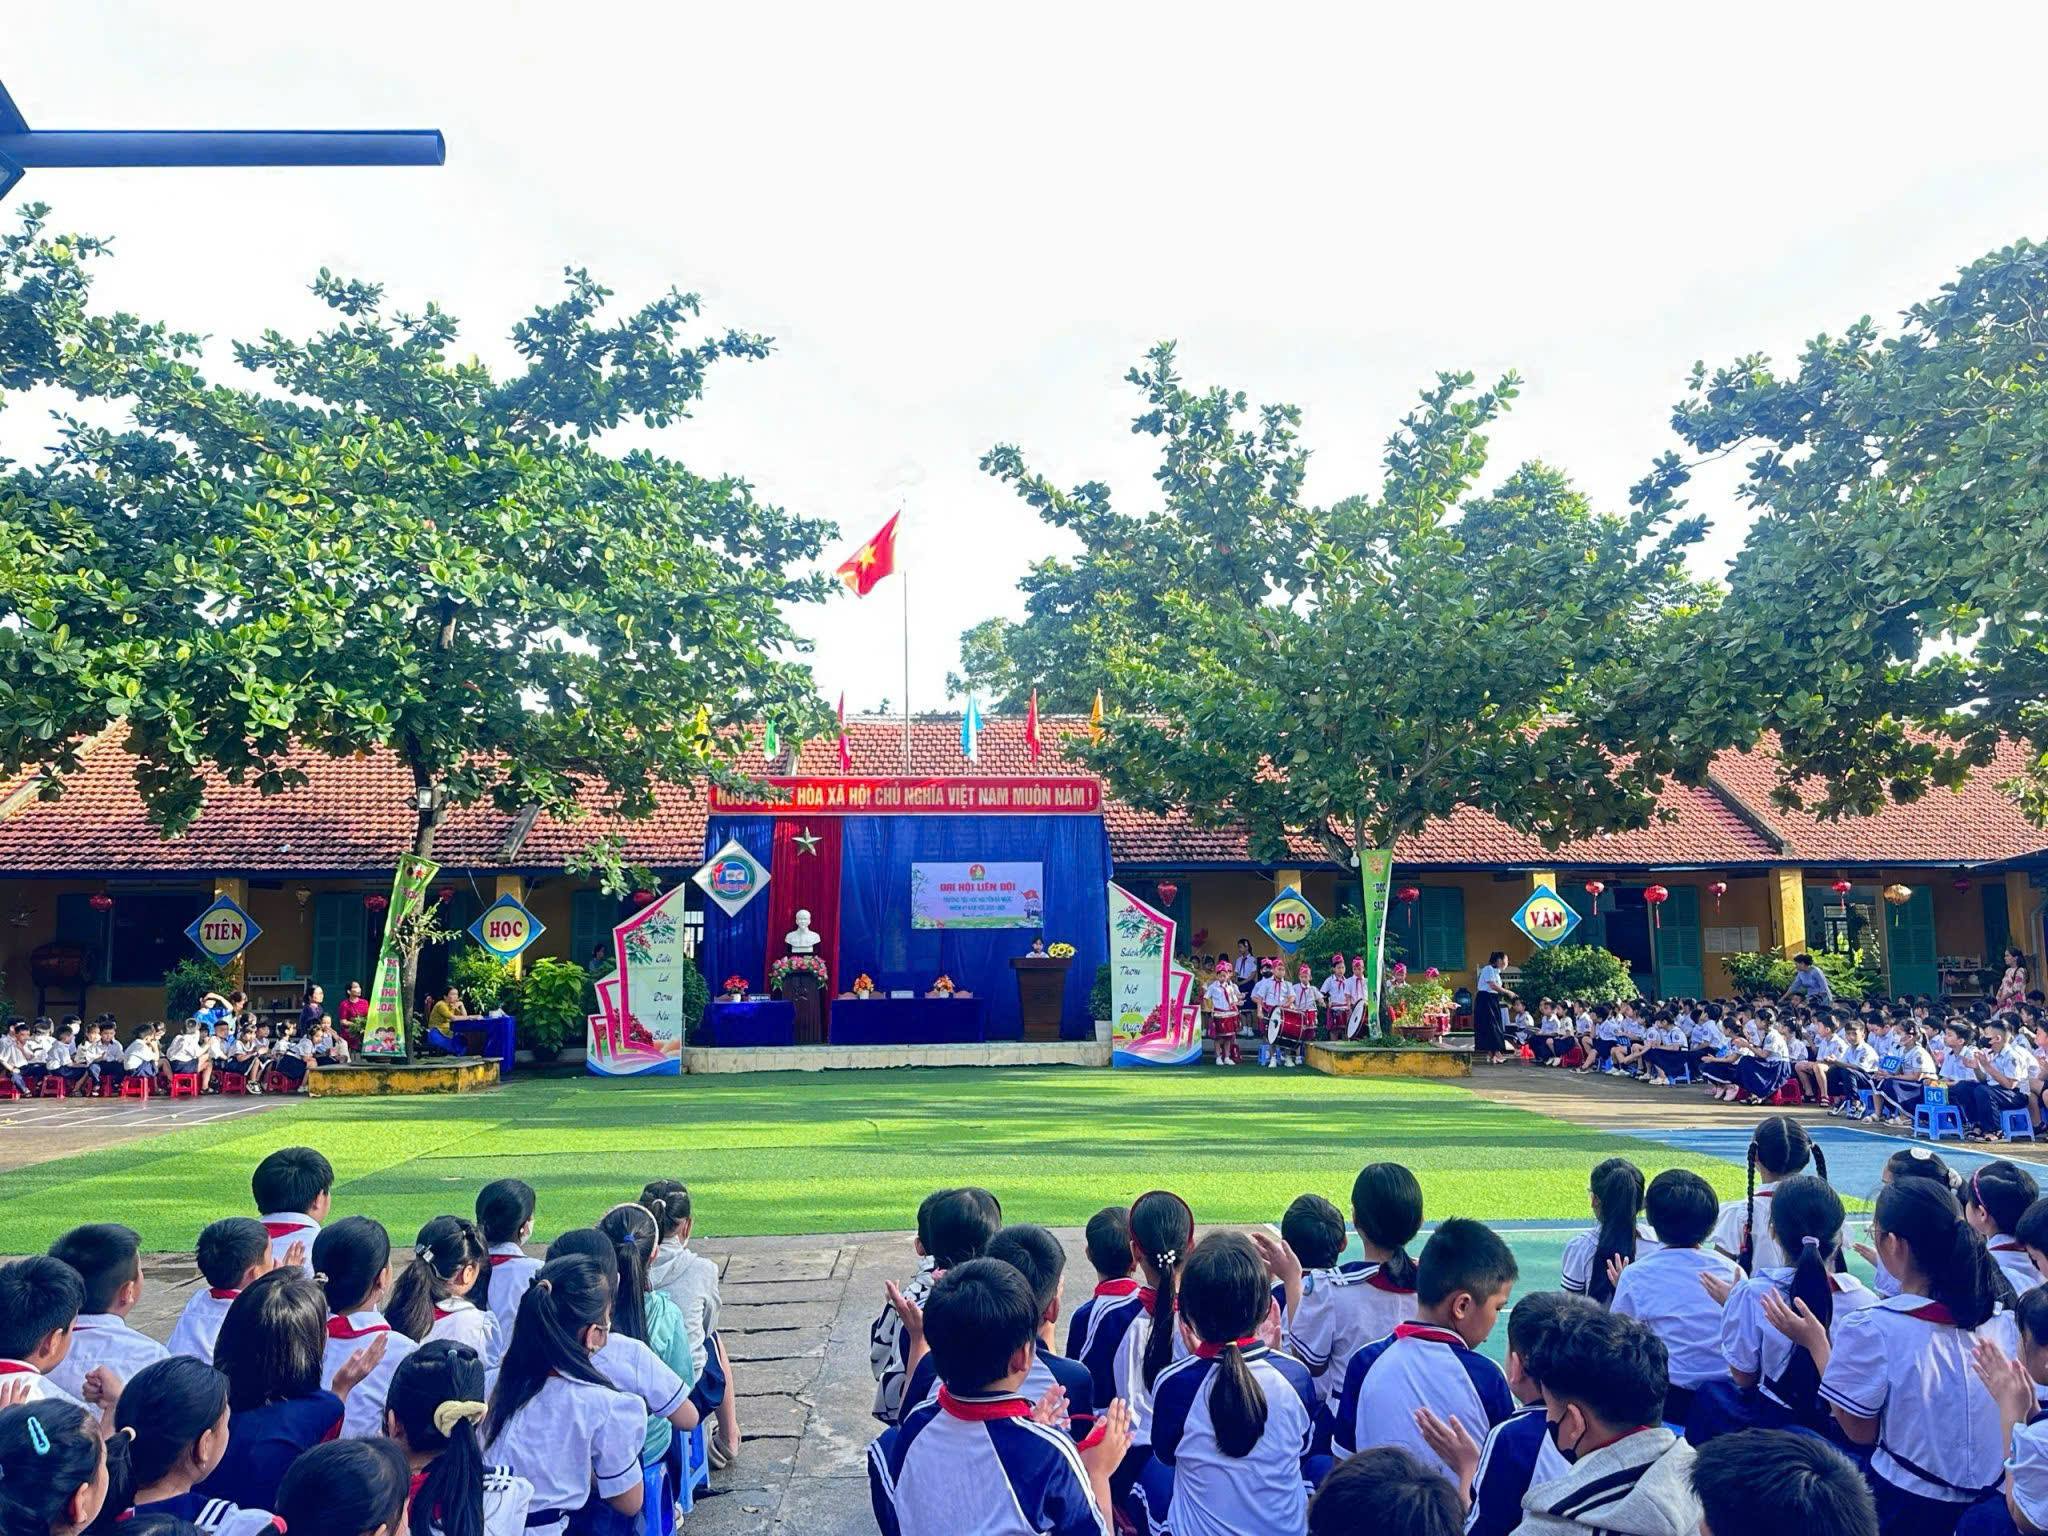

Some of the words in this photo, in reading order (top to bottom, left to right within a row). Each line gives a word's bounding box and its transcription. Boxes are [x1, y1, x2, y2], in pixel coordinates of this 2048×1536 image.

[797, 784, 824, 806] HÒA
[827, 784, 845, 806] XÃ
[850, 783, 870, 810] HỘI
[875, 781, 900, 806] CHỦ
[904, 784, 945, 806] NGHĨA
[948, 784, 975, 809] VIỆT
[978, 787, 1009, 806] NAM
[1012, 784, 1050, 806] MUÔN
[1054, 784, 1085, 806] NĂM
[1276, 913, 1306, 933] HỌC
[1530, 907, 1562, 927] VĂN
[204, 918, 242, 940] TIÊN
[490, 921, 522, 941] HỌC
[1883, 1059, 1897, 1069] 3B
[1927, 1090, 1942, 1101] 3C
